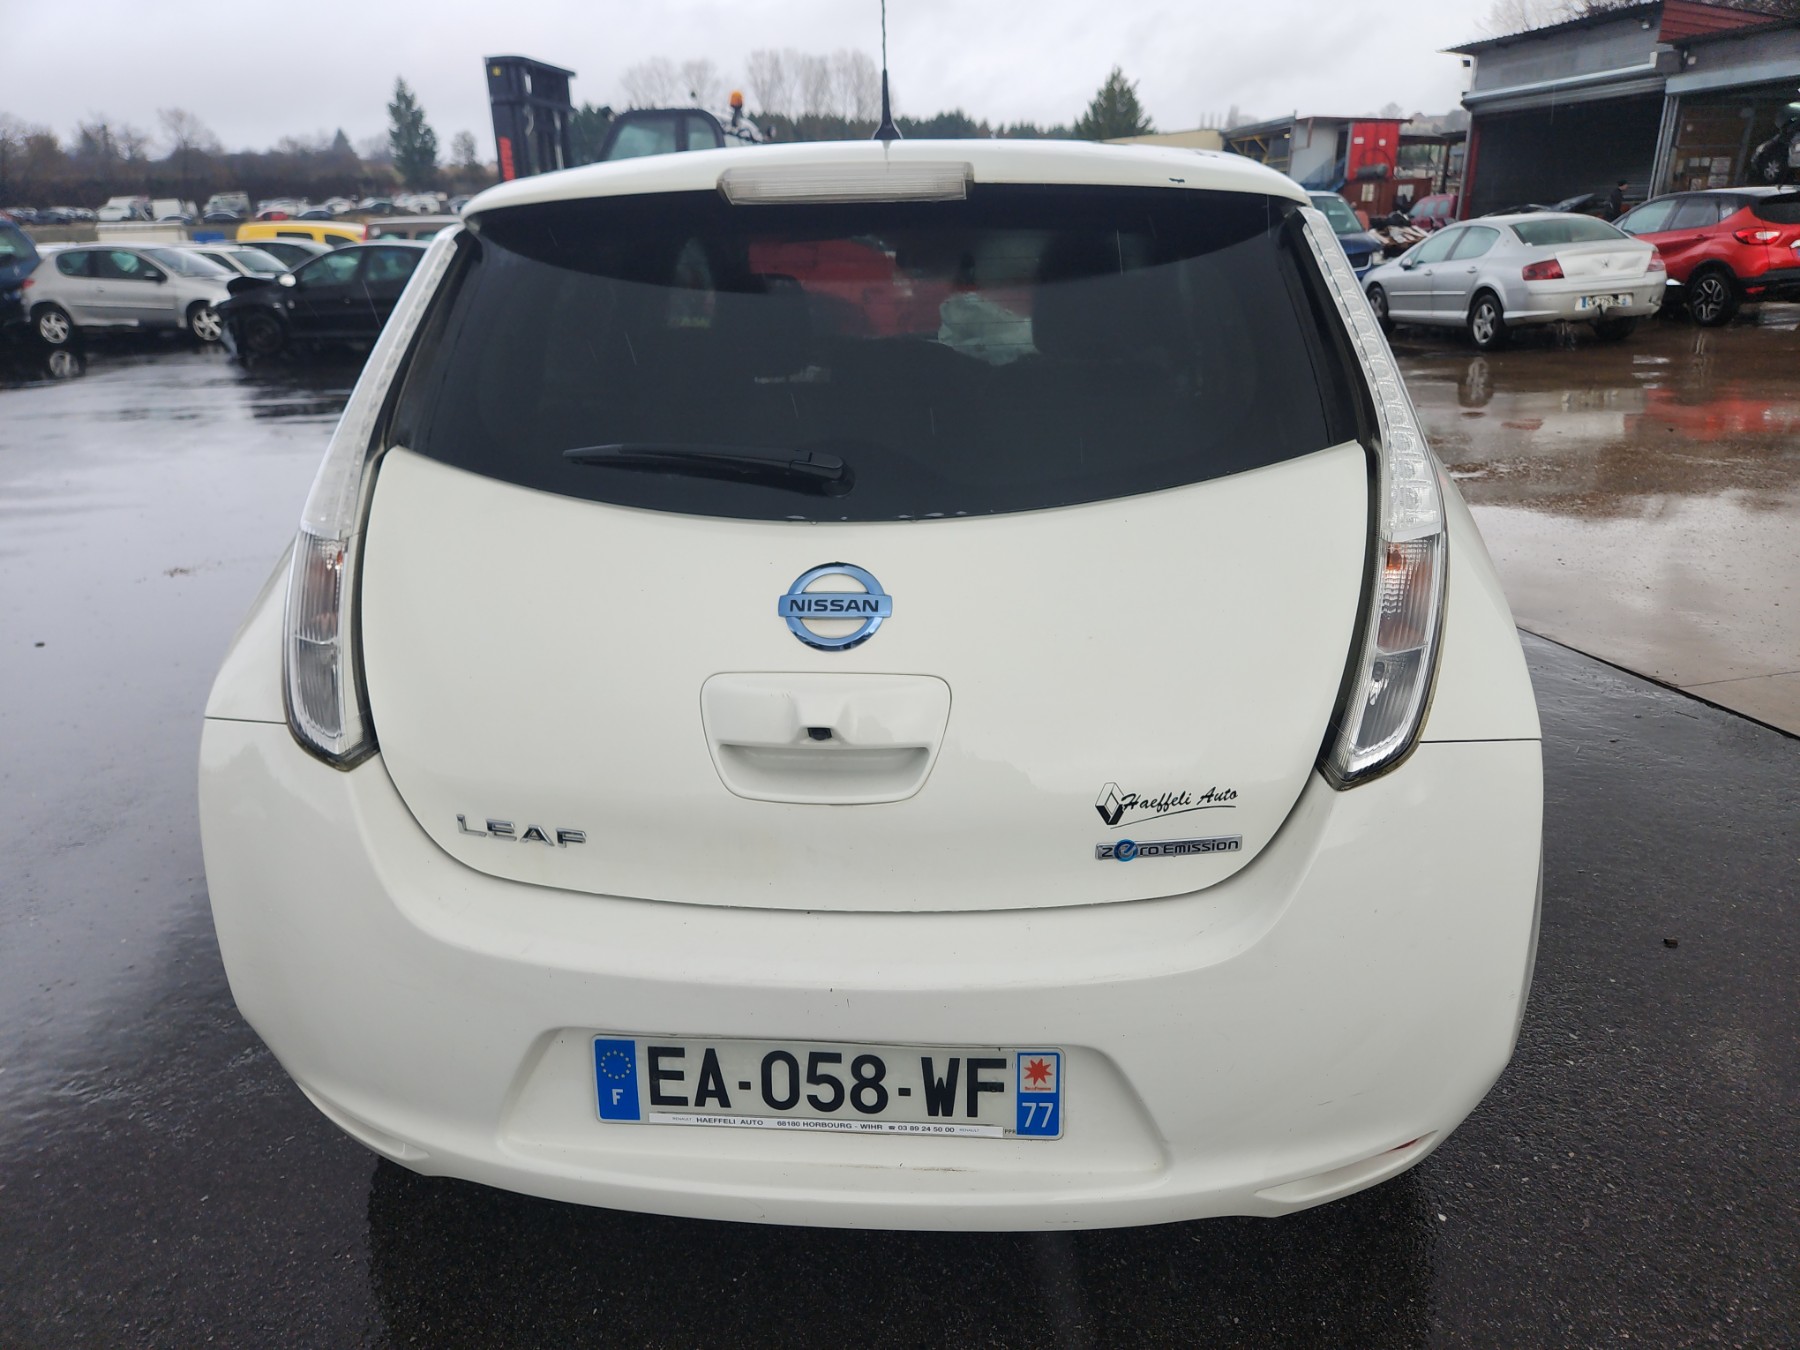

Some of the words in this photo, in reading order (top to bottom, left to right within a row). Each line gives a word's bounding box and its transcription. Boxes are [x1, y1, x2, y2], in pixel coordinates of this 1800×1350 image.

[789, 599, 879, 613] NISSAN
[1121, 791, 1192, 813] Haeffeli
[1197, 786, 1239, 806] Auto
[456, 813, 587, 849] LEAF
[647, 1045, 1007, 1118] EA-058-WF
[611, 1088, 624, 1106] F
[696, 1117, 736, 1125] HAEFFELI
[1021, 1102, 1054, 1128] 77
